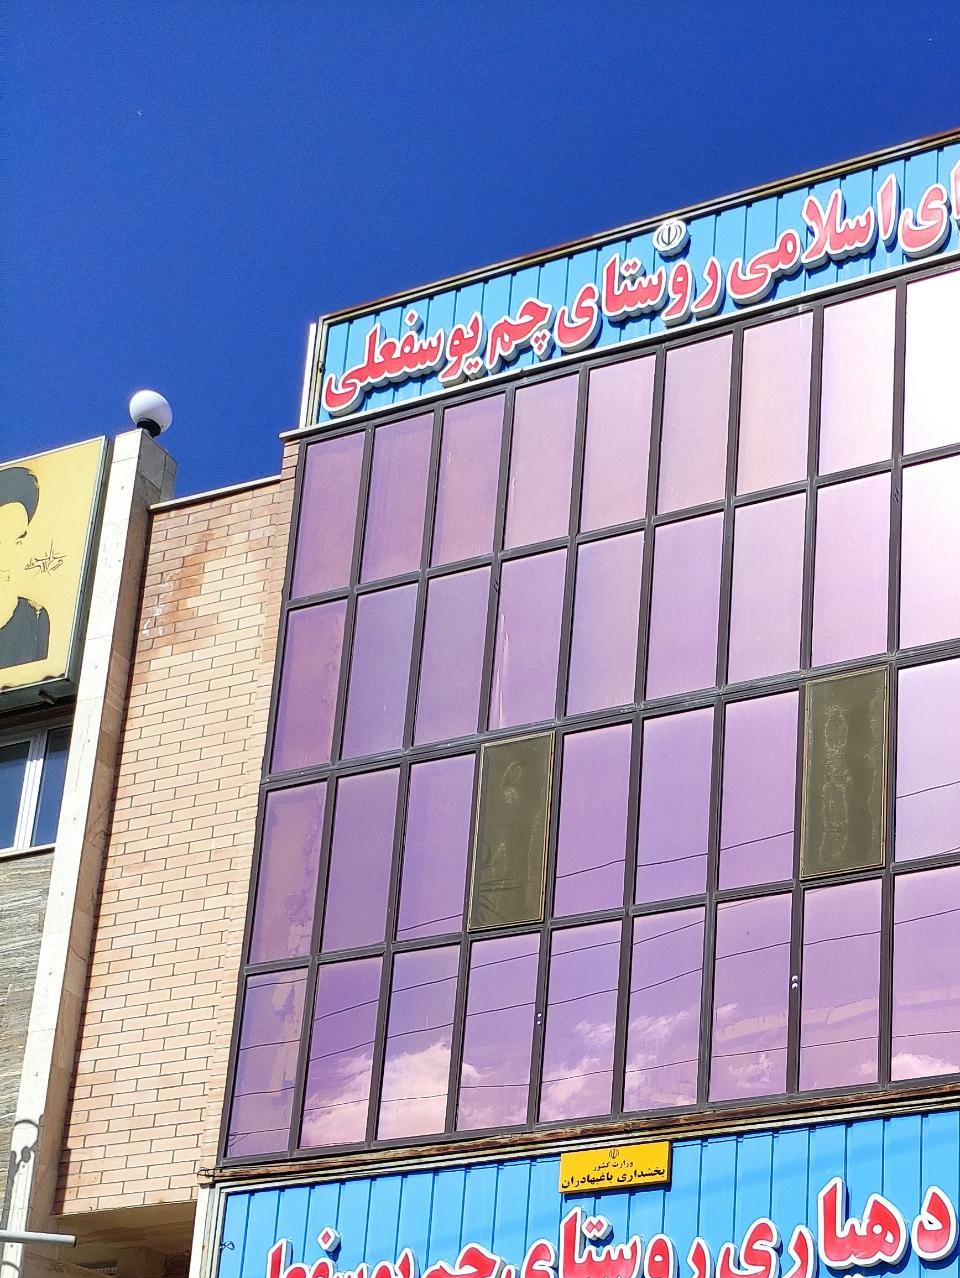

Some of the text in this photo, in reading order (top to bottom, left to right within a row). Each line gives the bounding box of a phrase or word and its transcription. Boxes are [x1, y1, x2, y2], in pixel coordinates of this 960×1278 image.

[726, 173, 898, 302] اسلامی
[486, 297, 552, 369] چم
[554, 254, 721, 348] روستای
[322, 309, 483, 412] یوسفعلی
[561, 1165, 666, 1189] بخشداری باغبهادران
[592, 1159, 634, 1172] وزارت کشور
